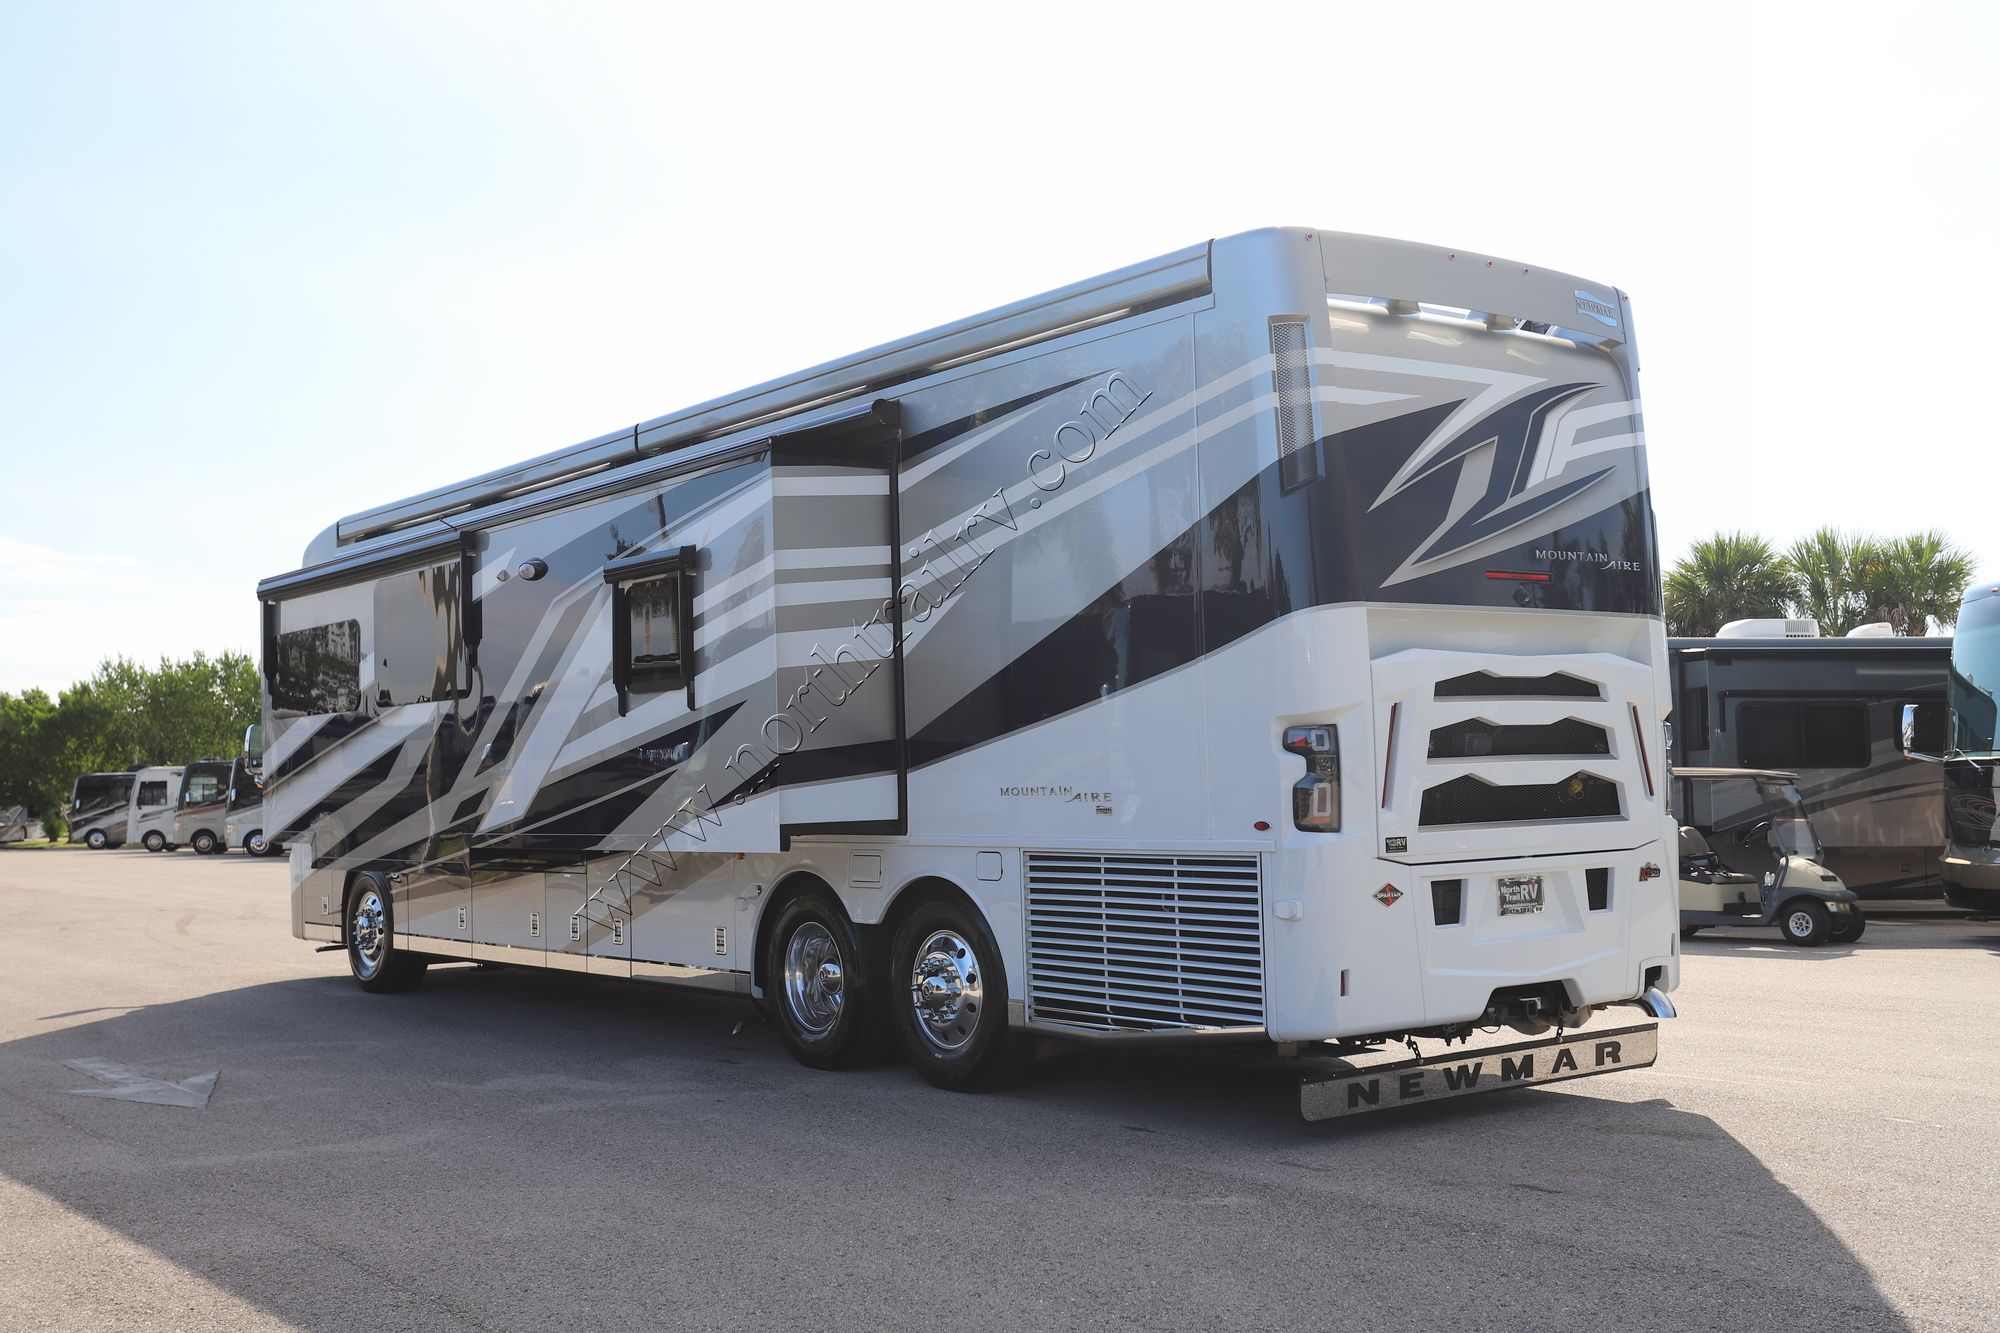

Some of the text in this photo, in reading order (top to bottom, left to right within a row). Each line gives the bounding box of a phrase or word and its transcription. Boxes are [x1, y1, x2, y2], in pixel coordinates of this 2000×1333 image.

[1575, 298, 1615, 320] NEWMAR
[1535, 549, 1641, 571] MOUNTAIN AIRE
[999, 785, 1113, 803] MOUNTAIN AIRE
[1501, 883, 1539, 900] North RV
[1504, 893, 1520, 901] Trail
[1347, 1040, 1622, 1109] NEWMAR
